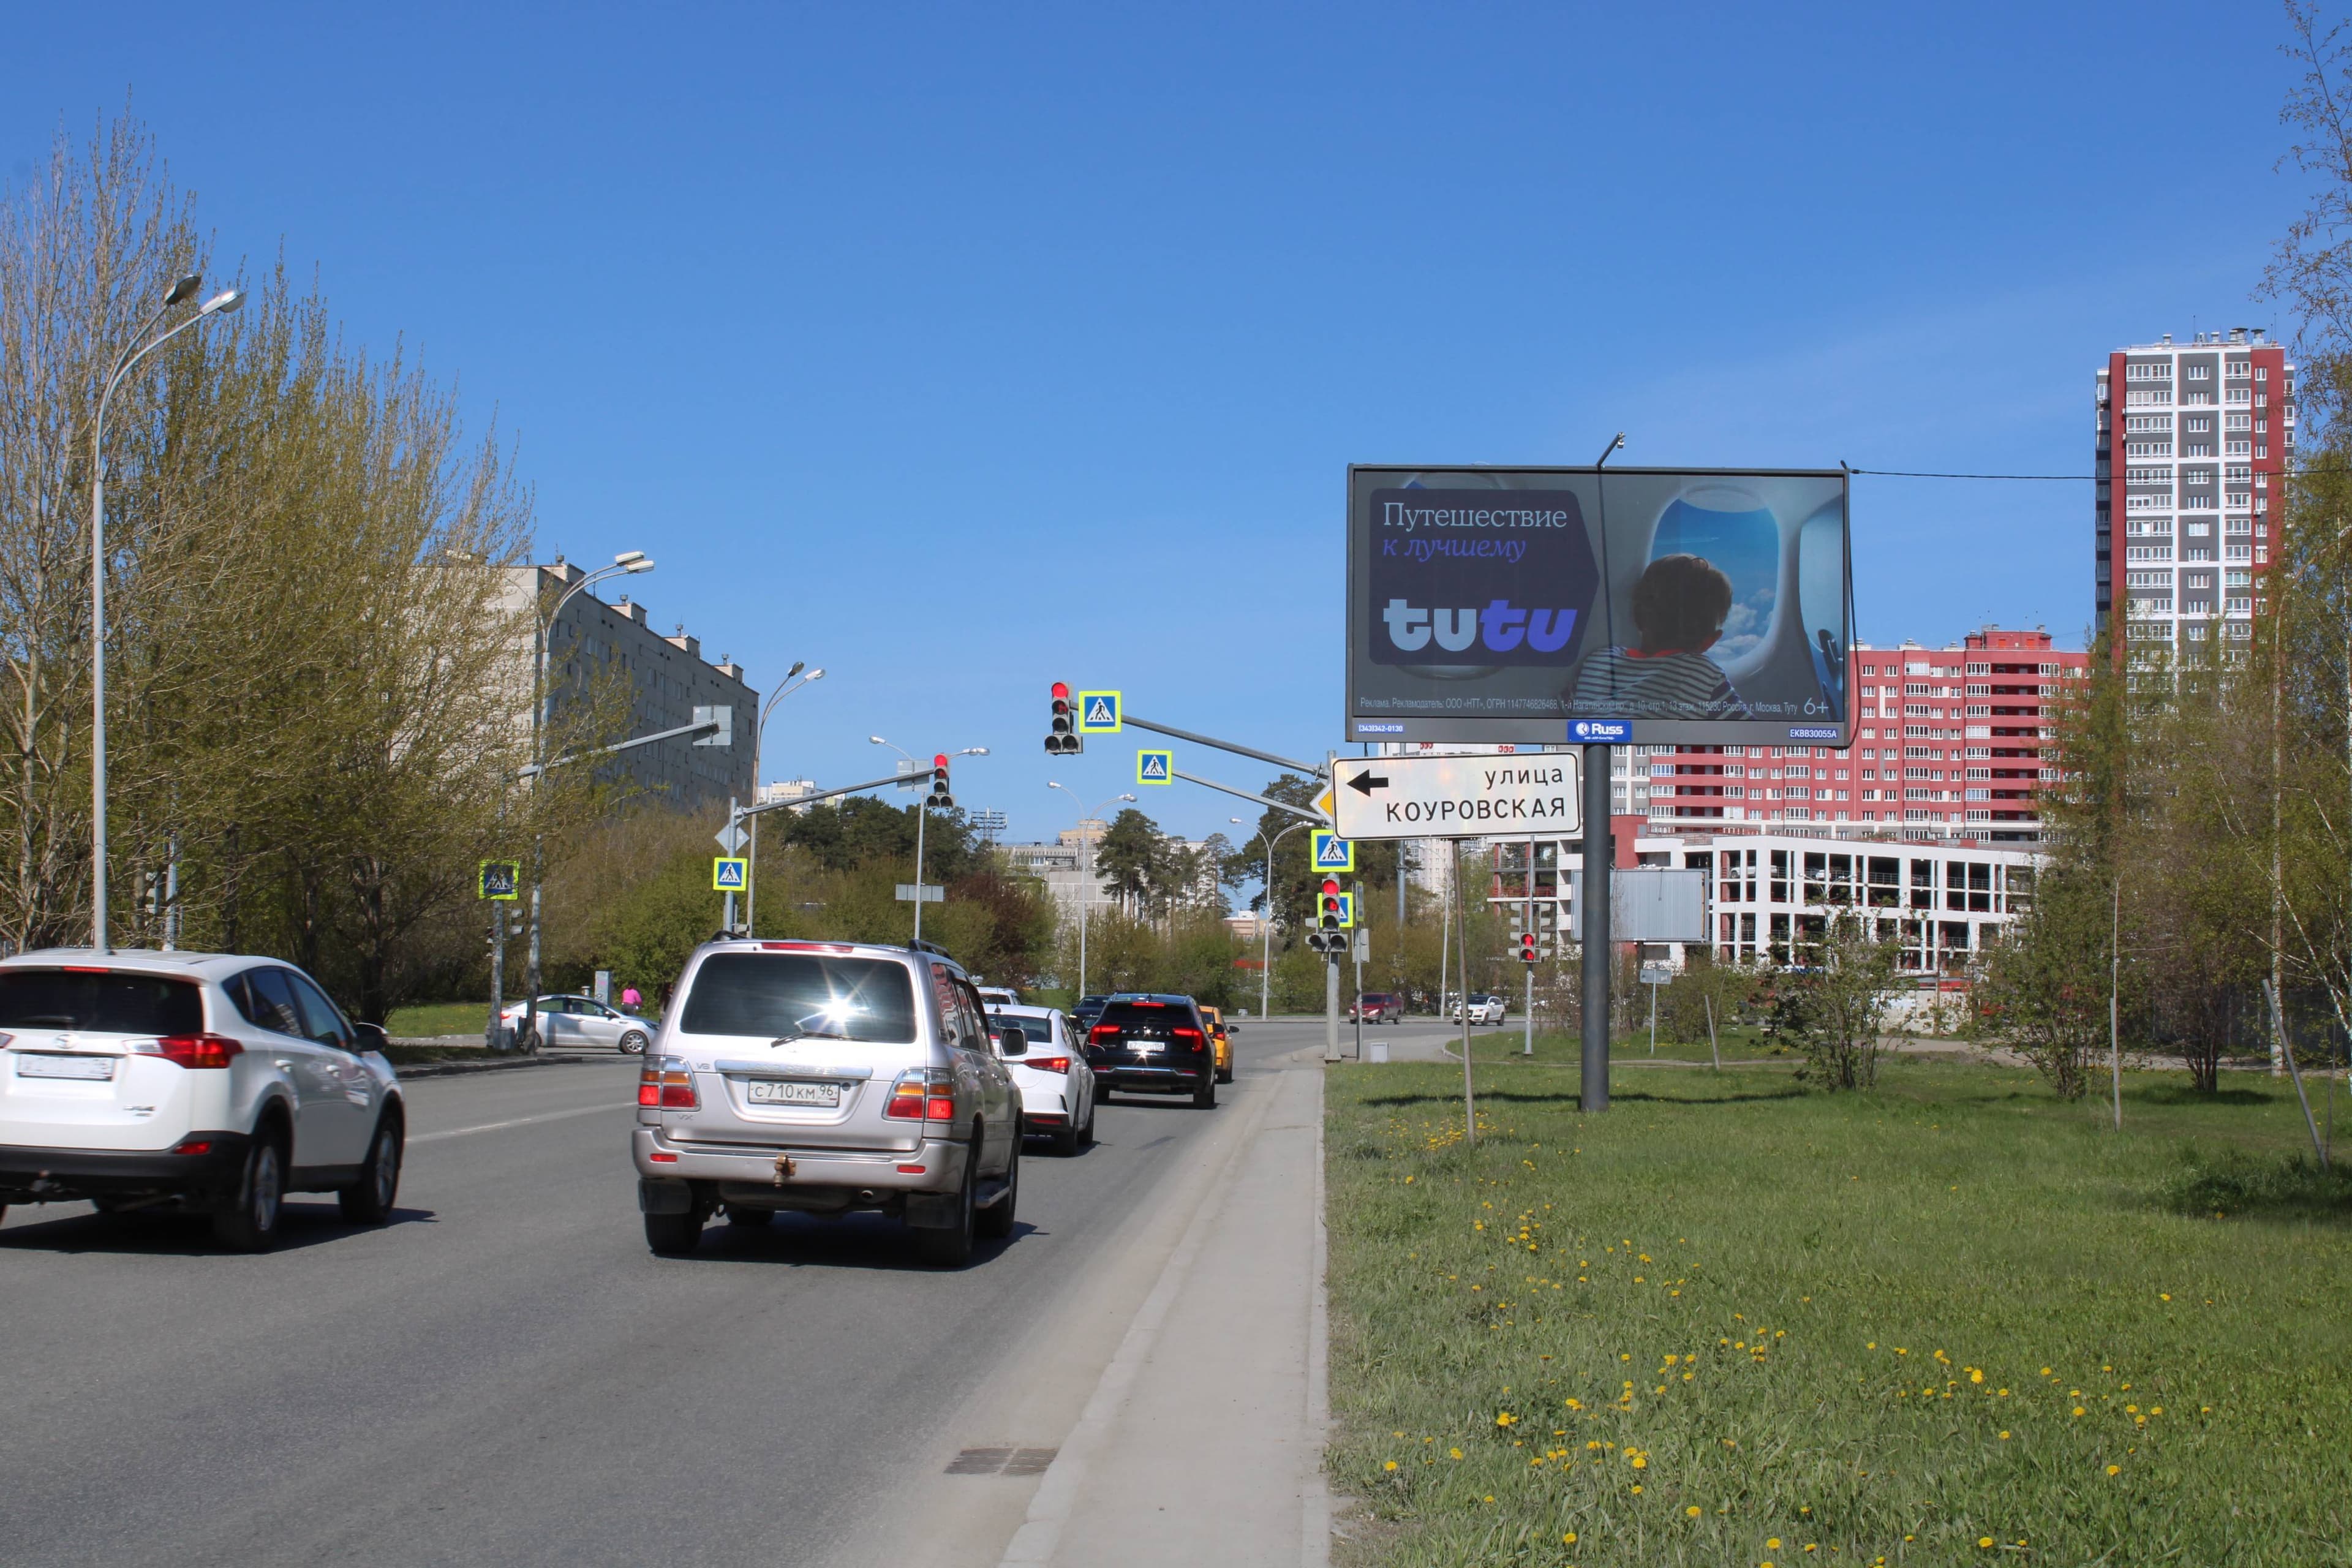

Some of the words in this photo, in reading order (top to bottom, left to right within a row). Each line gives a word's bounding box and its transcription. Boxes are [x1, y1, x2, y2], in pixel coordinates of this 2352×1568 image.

[1382, 502, 1568, 532] Путешествие
[1382, 540, 1398, 556] к
[1404, 538, 1526, 563] лучшему
[1383, 598, 1577, 652] tutu
[1360, 697, 1390, 709] Реклама.
[1392, 698, 1444, 710] Рекламодатель:
[1446, 698, 1463, 709] ООО
[1487, 698, 1506, 709] ОГРН
[1755, 702, 1782, 713] Москва,
[1783, 702, 1798, 715] Туту
[1804, 697, 1829, 715] 6+
[1591, 723, 1624, 735] Russ
[1485, 768, 1563, 790] улица
[1386, 797, 1565, 822] КОУРОВСКАЯ
